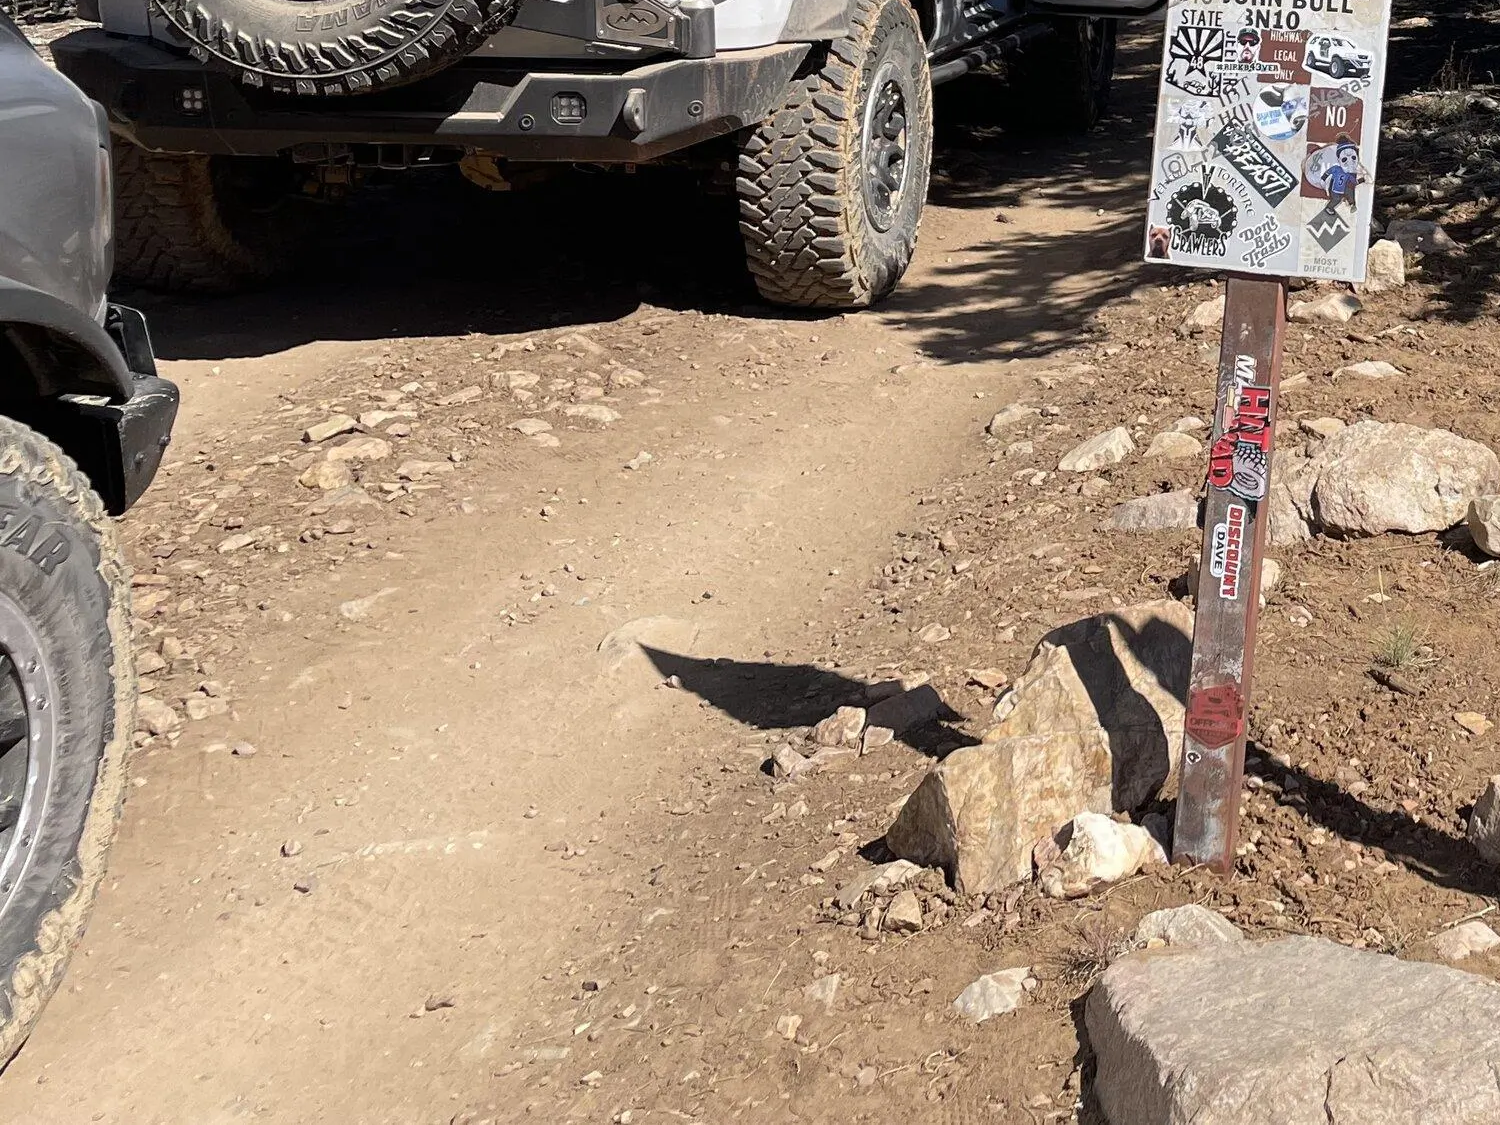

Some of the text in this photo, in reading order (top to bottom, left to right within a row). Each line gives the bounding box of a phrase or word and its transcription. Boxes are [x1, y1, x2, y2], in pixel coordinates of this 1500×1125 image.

[1181, 9, 1223, 26] STATE
[1190, 56, 1203, 69] 48
[1274, 50, 1297, 62] LEGAL
[1275, 70, 1294, 81] ONLY
[1325, 106, 1347, 128] NO
[1239, 215, 1278, 242] Don't
[1171, 227, 1227, 257] CRAWLERS
[1254, 231, 1272, 248] Be
[1242, 233, 1290, 267] Trashy
[1303, 265, 1347, 276] DIFFICULT
[1314, 258, 1337, 266] MOST
[1214, 531, 1226, 569] DAVE
[1222, 507, 1243, 597] DISCOUNT
